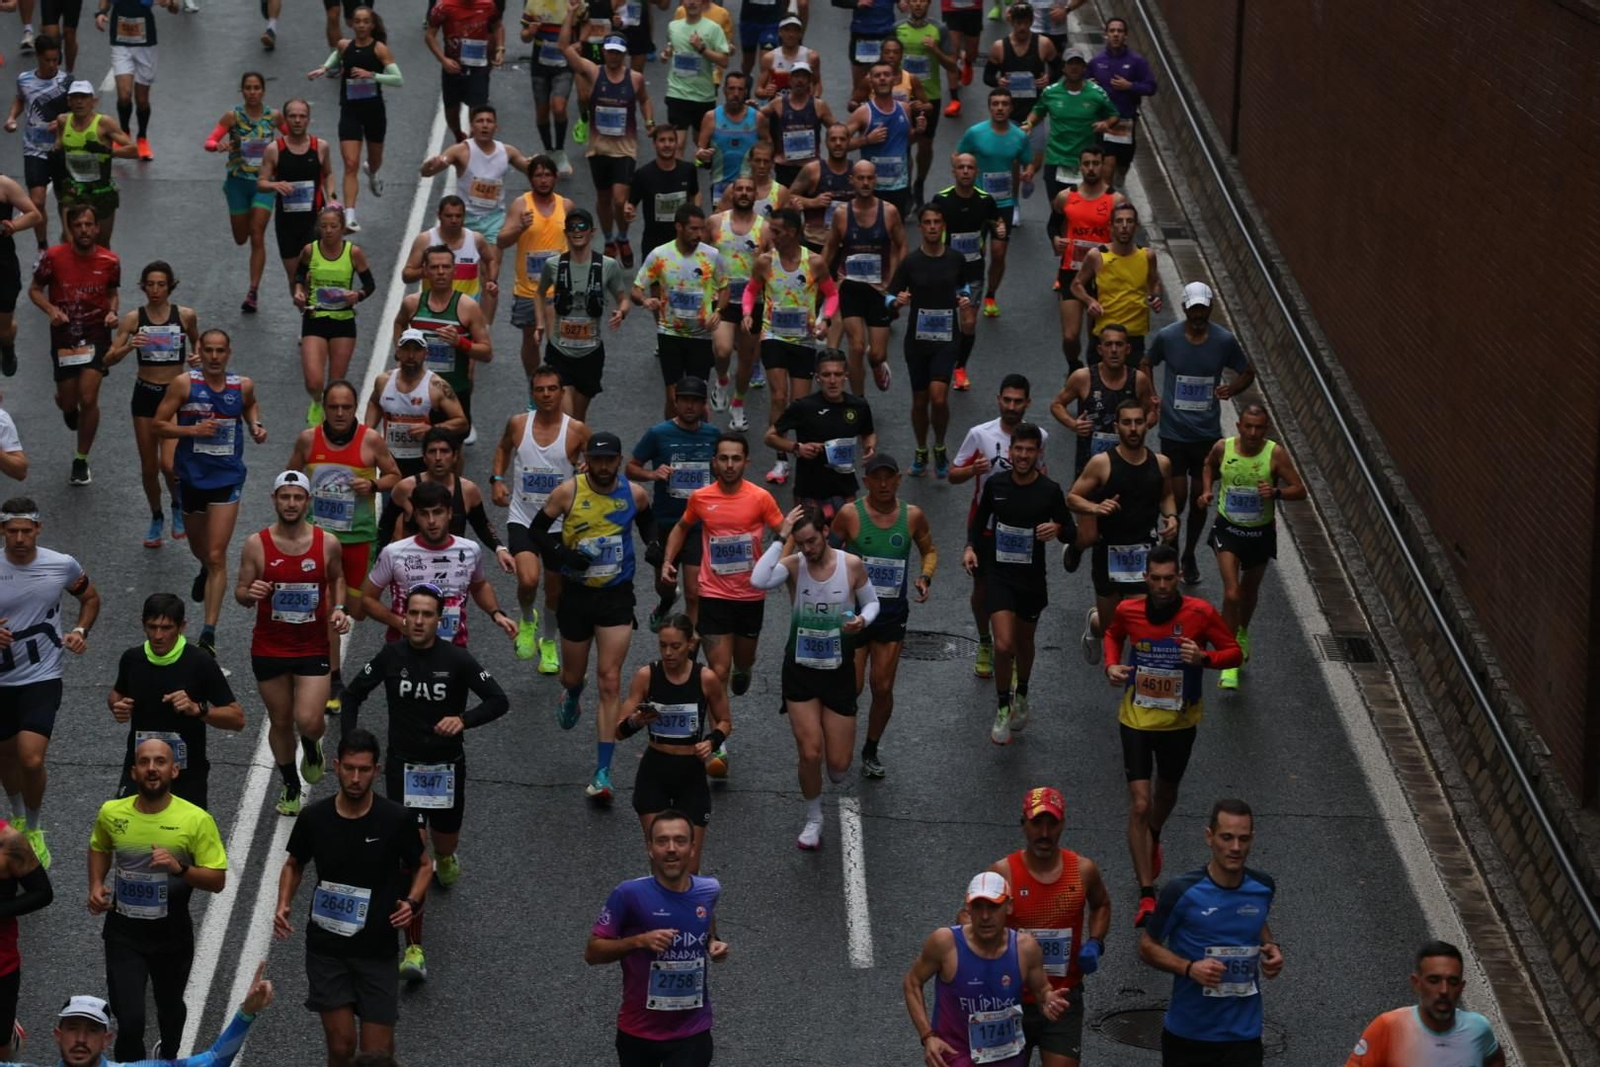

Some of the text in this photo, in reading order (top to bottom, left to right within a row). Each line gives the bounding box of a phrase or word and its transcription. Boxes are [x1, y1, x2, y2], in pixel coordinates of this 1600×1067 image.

[527, 474, 554, 487] 2430
[399, 679, 448, 701] PAS
[1141, 677, 1171, 692] 4610
[411, 775, 442, 790] 3347
[121, 881, 154, 898] 2899
[321, 893, 355, 914] 2648
[657, 973, 694, 989] 2758
[979, 1021, 1011, 1040] 1741
